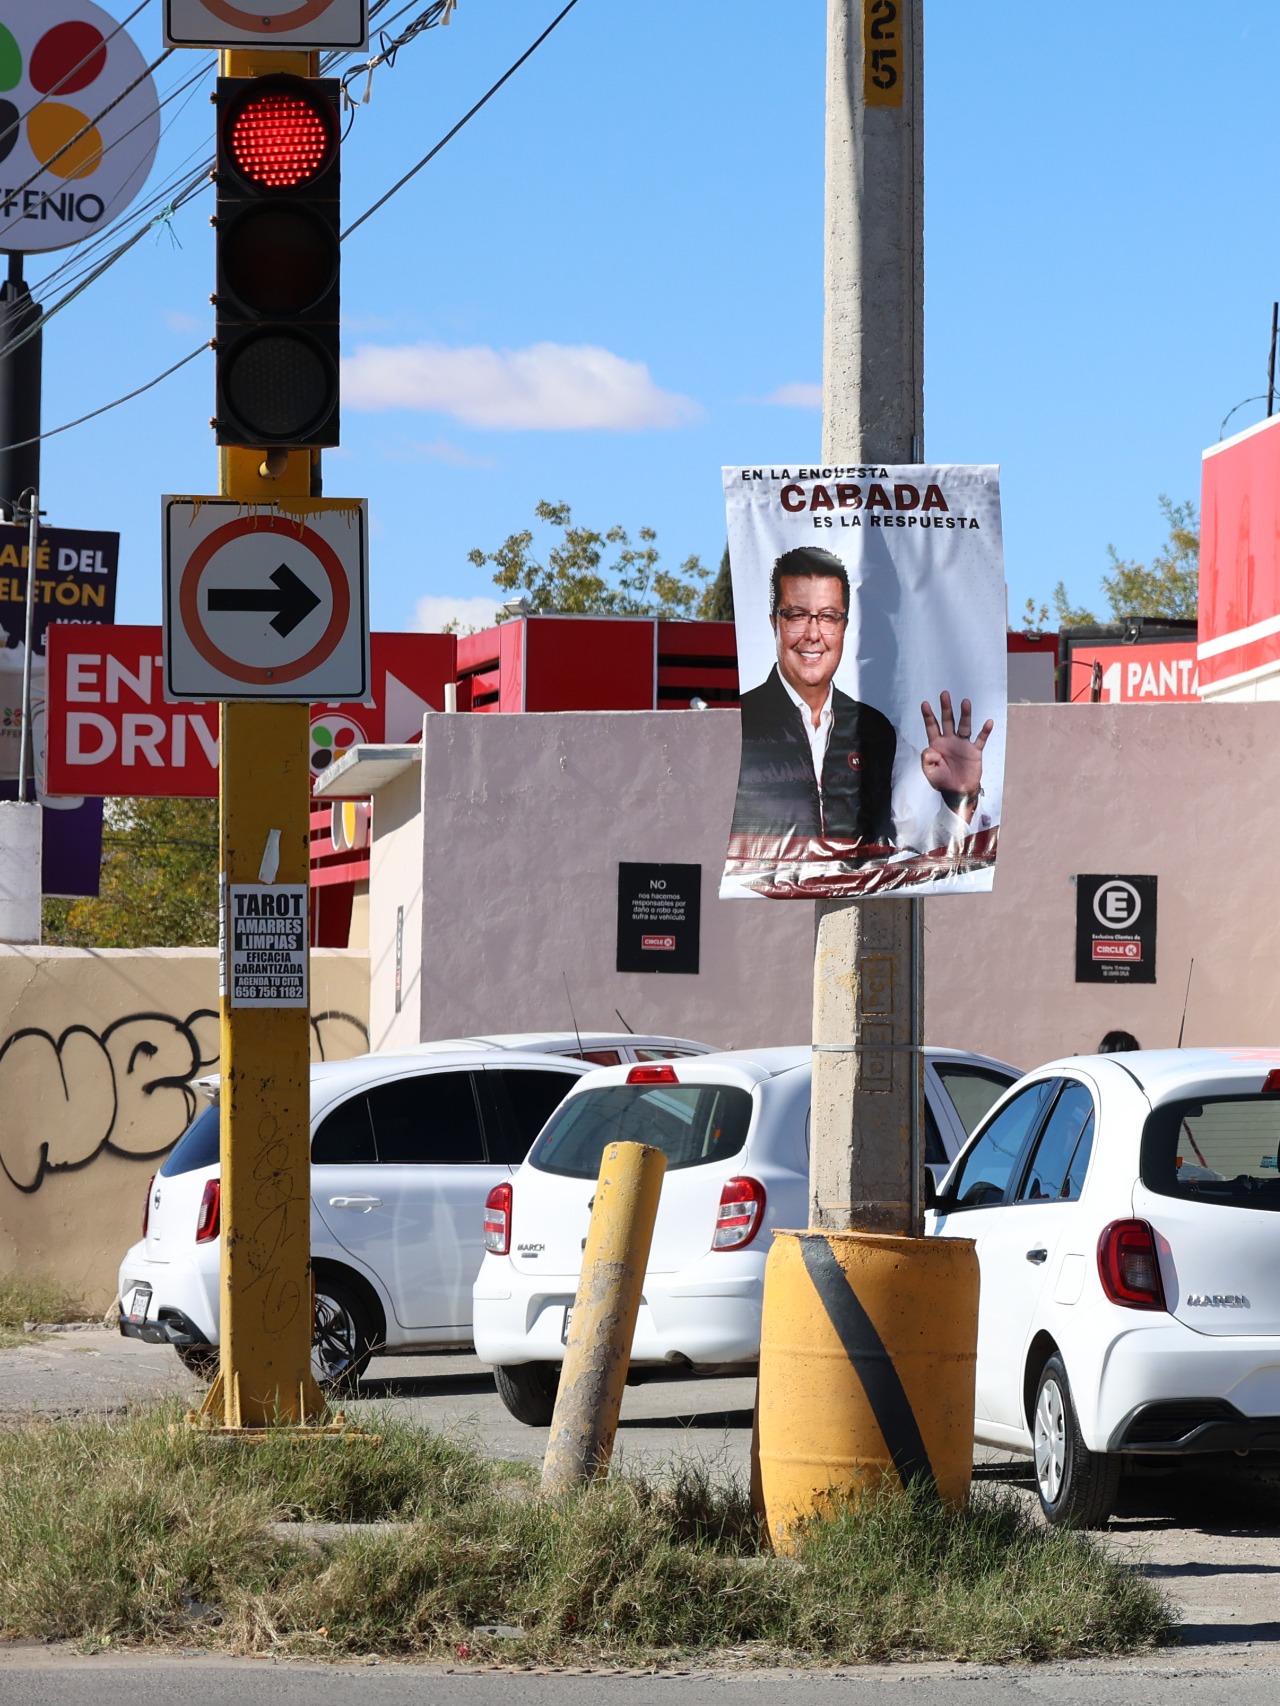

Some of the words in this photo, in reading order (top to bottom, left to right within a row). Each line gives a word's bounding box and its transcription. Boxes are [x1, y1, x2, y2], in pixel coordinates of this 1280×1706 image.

[3, 187, 105, 223] FENIO
[741, 469, 763, 481] EN
[771, 468, 791, 480] LA
[798, 467, 889, 480] ENCUESTA
[780, 483, 949, 513] CABADA
[813, 516, 833, 528] ES
[841, 515, 862, 528] LA
[870, 515, 980, 529] RESPUESTA
[57, 547, 108, 574] DEL
[65, 711, 220, 768] DRIV
[649, 879, 667, 890] NO
[632, 899, 674, 907] responsables
[651, 892, 680, 900] hacemos
[234, 893, 303, 916] TAROT
[1106, 891, 1128, 918] E
[236, 919, 302, 934] AMARRES
[241, 934, 297, 950] LIMPIAS
[1096, 945, 1124, 954] CIRCLE
[246, 951, 292, 963] EFICACIA
[234, 963, 304, 974] GARANTIZADA
[238, 977, 269, 986] AGENDA
[270, 977, 280, 986] TU
[283, 977, 300, 986] CITA
[235, 986, 257, 998] 656
[260, 986, 278, 997] 756
[280, 986, 303, 997] 1182
